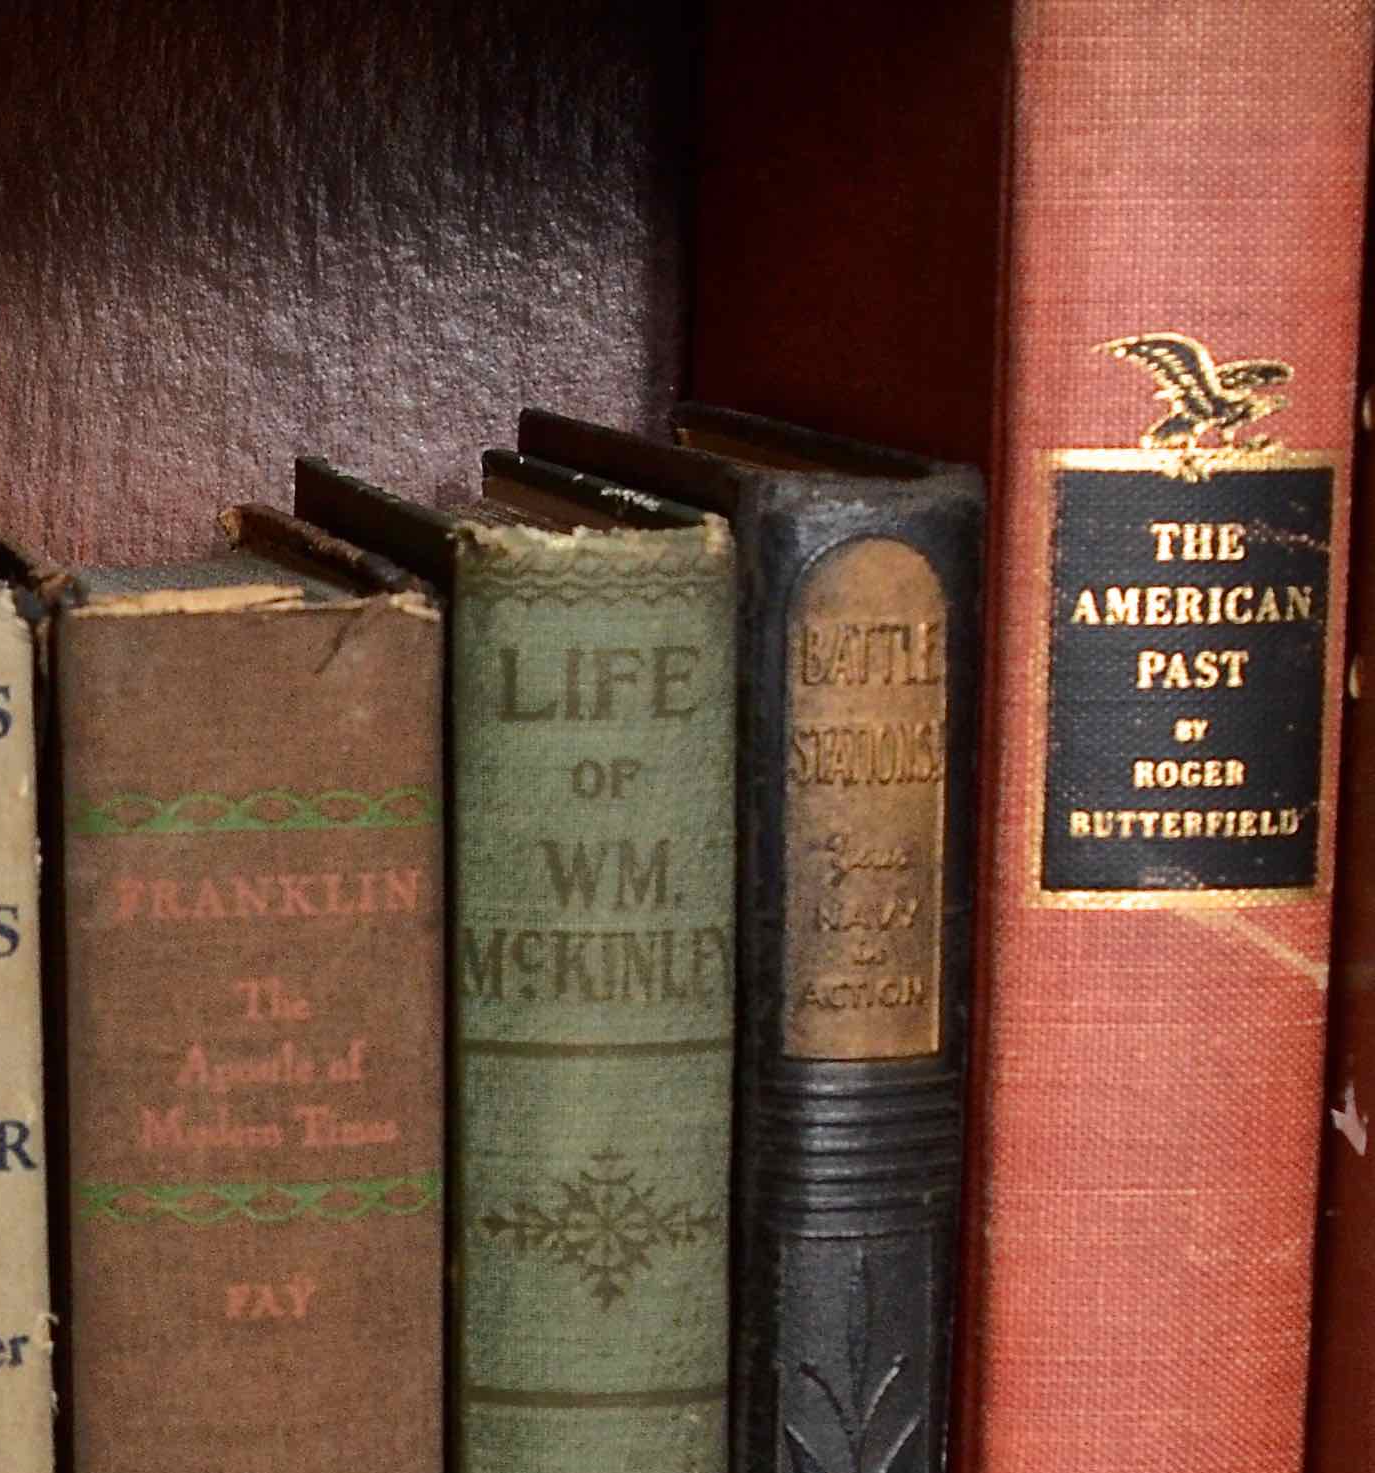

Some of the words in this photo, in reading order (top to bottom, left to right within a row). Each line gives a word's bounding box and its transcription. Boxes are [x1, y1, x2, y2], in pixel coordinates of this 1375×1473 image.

[1150, 521, 1246, 562] THE
[1070, 585, 1313, 626] AMERICAN
[800, 622, 942, 687] BATTLE
[1136, 650, 1249, 690] PAST
[497, 645, 702, 722] LIFE
[1173, 718, 1209, 743] BY
[567, 757, 643, 800] OF
[1133, 759, 1246, 789] ROGER
[1069, 809, 1299, 840] BUTTERFIELD
[112, 867, 422, 922] FRANKLIN
[534, 837, 685, 911] WM.
[233, 976, 315, 1024] The
[225, 1272, 318, 1320] FAY
